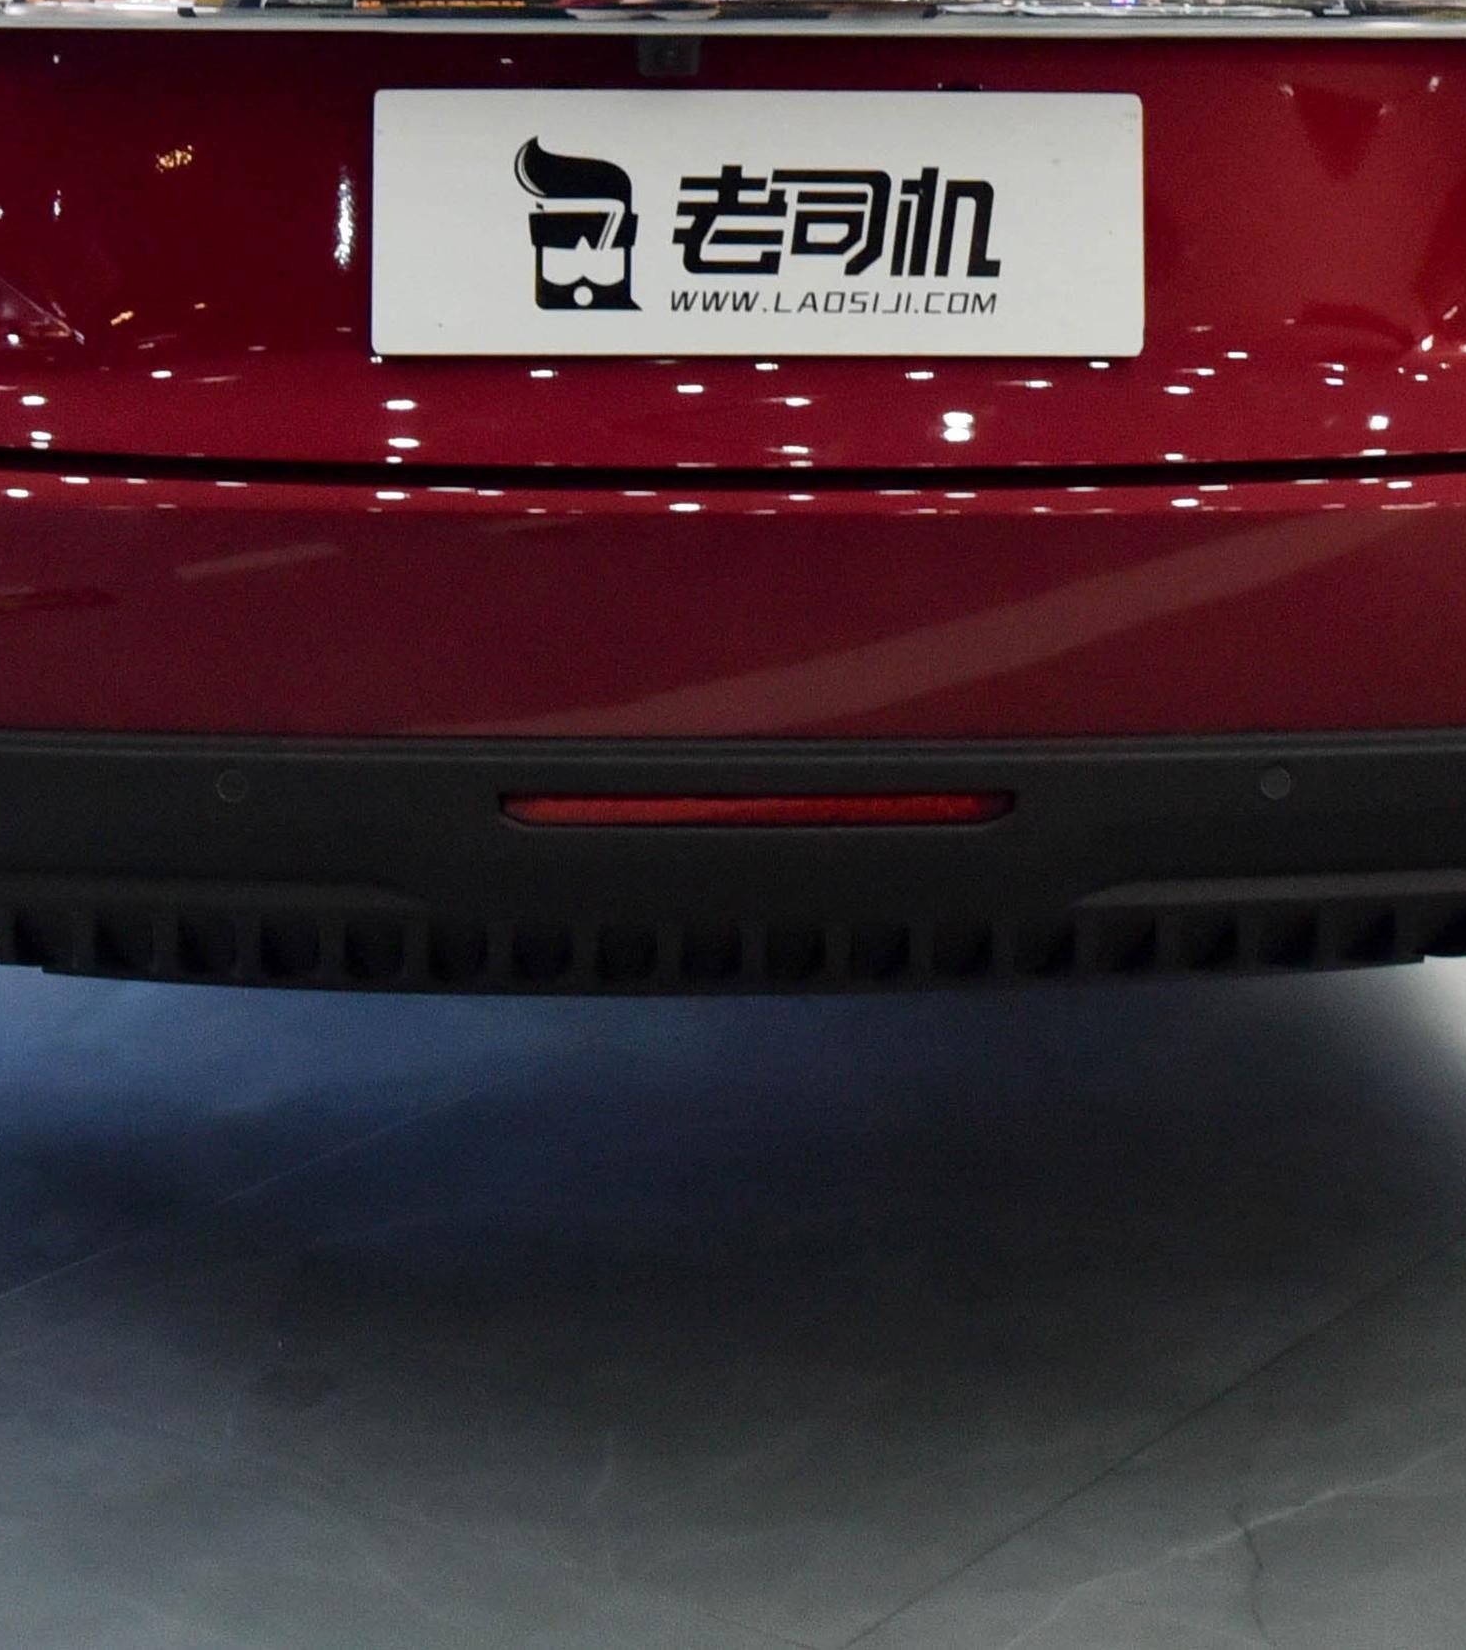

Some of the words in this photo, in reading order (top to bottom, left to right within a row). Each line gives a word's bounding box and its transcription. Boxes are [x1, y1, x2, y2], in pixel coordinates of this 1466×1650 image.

[671, 165, 1002, 278] 老司机
[670, 290, 999, 316] WWW.LAOSIJI.COM
